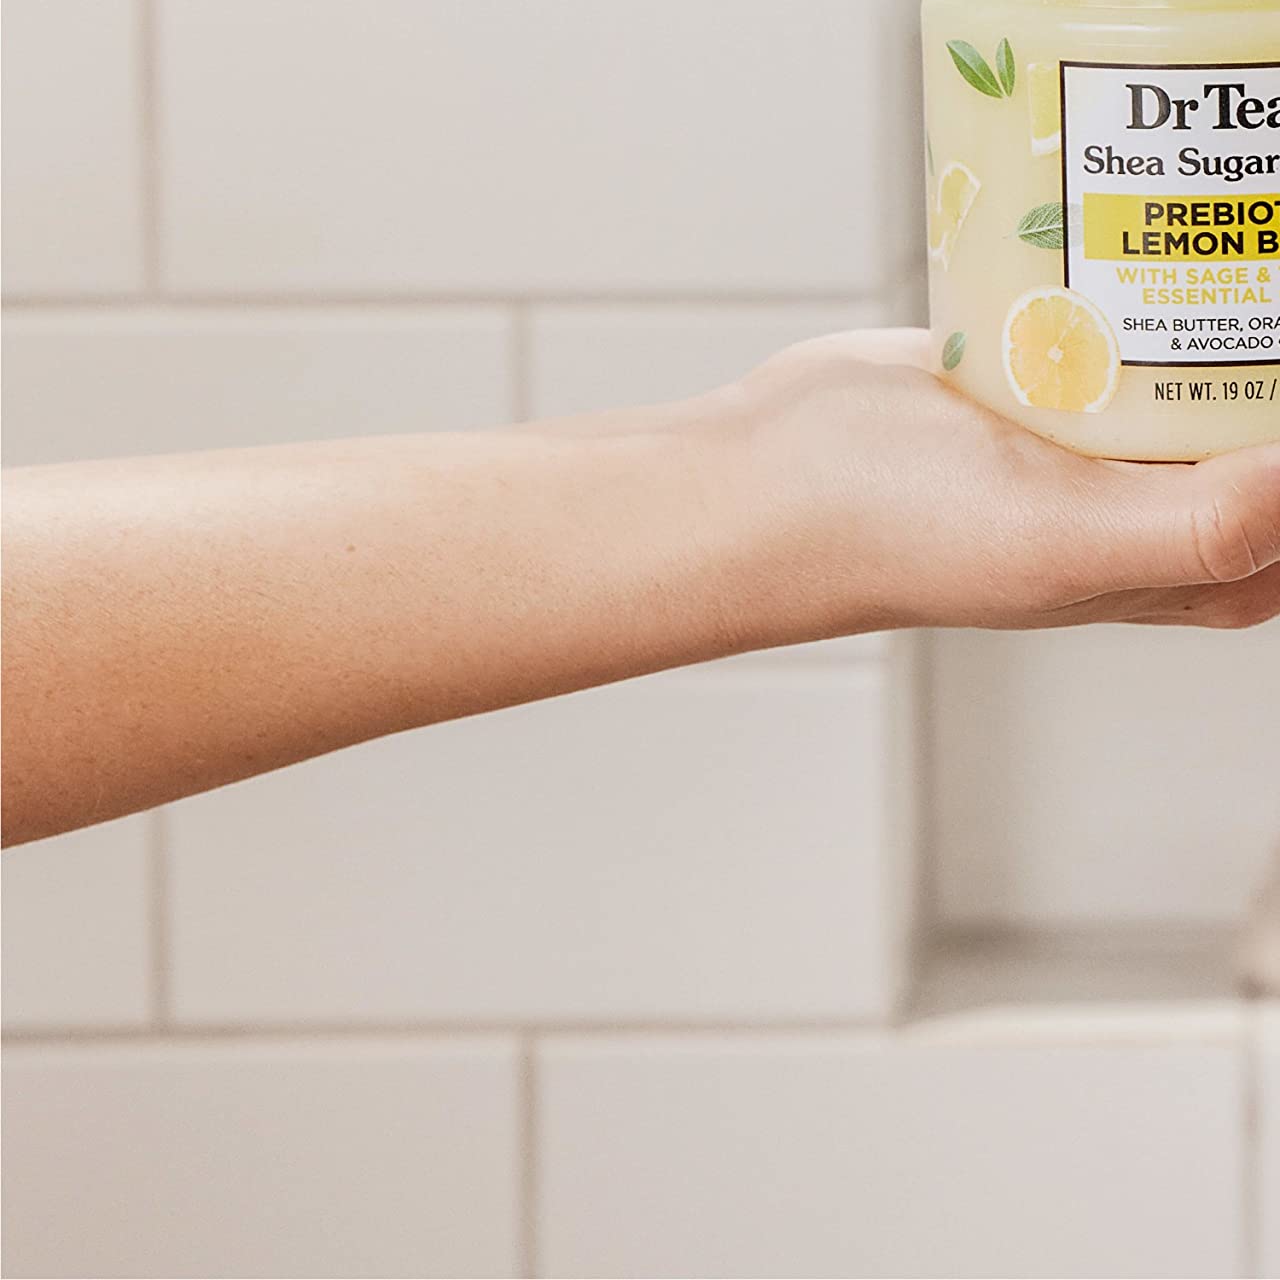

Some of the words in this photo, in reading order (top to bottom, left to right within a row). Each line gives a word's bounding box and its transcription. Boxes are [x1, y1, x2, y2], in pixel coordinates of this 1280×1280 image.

[1126, 84, 1198, 131] Dr
[1083, 145, 1165, 176] Shea
[1178, 147, 1280, 182] Sugar
[1122, 231, 1252, 256] LEMON
[1116, 267, 1176, 285] WITH
[1186, 266, 1249, 285] SAGE
[1256, 266, 1271, 283] &
[1142, 288, 1272, 305] ESSENTIAL
[1122, 318, 1167, 332] SHEA
[1173, 318, 1243, 333] BUTTER,
[1171, 338, 1182, 351] &
[1186, 336, 1273, 351] AVOCADO
[1155, 382, 1183, 401] NET
[1188, 382, 1217, 401] WT.
[1222, 381, 1239, 399] 19
[1245, 381, 1264, 399] OZ
[1270, 379, 1277, 400] /
